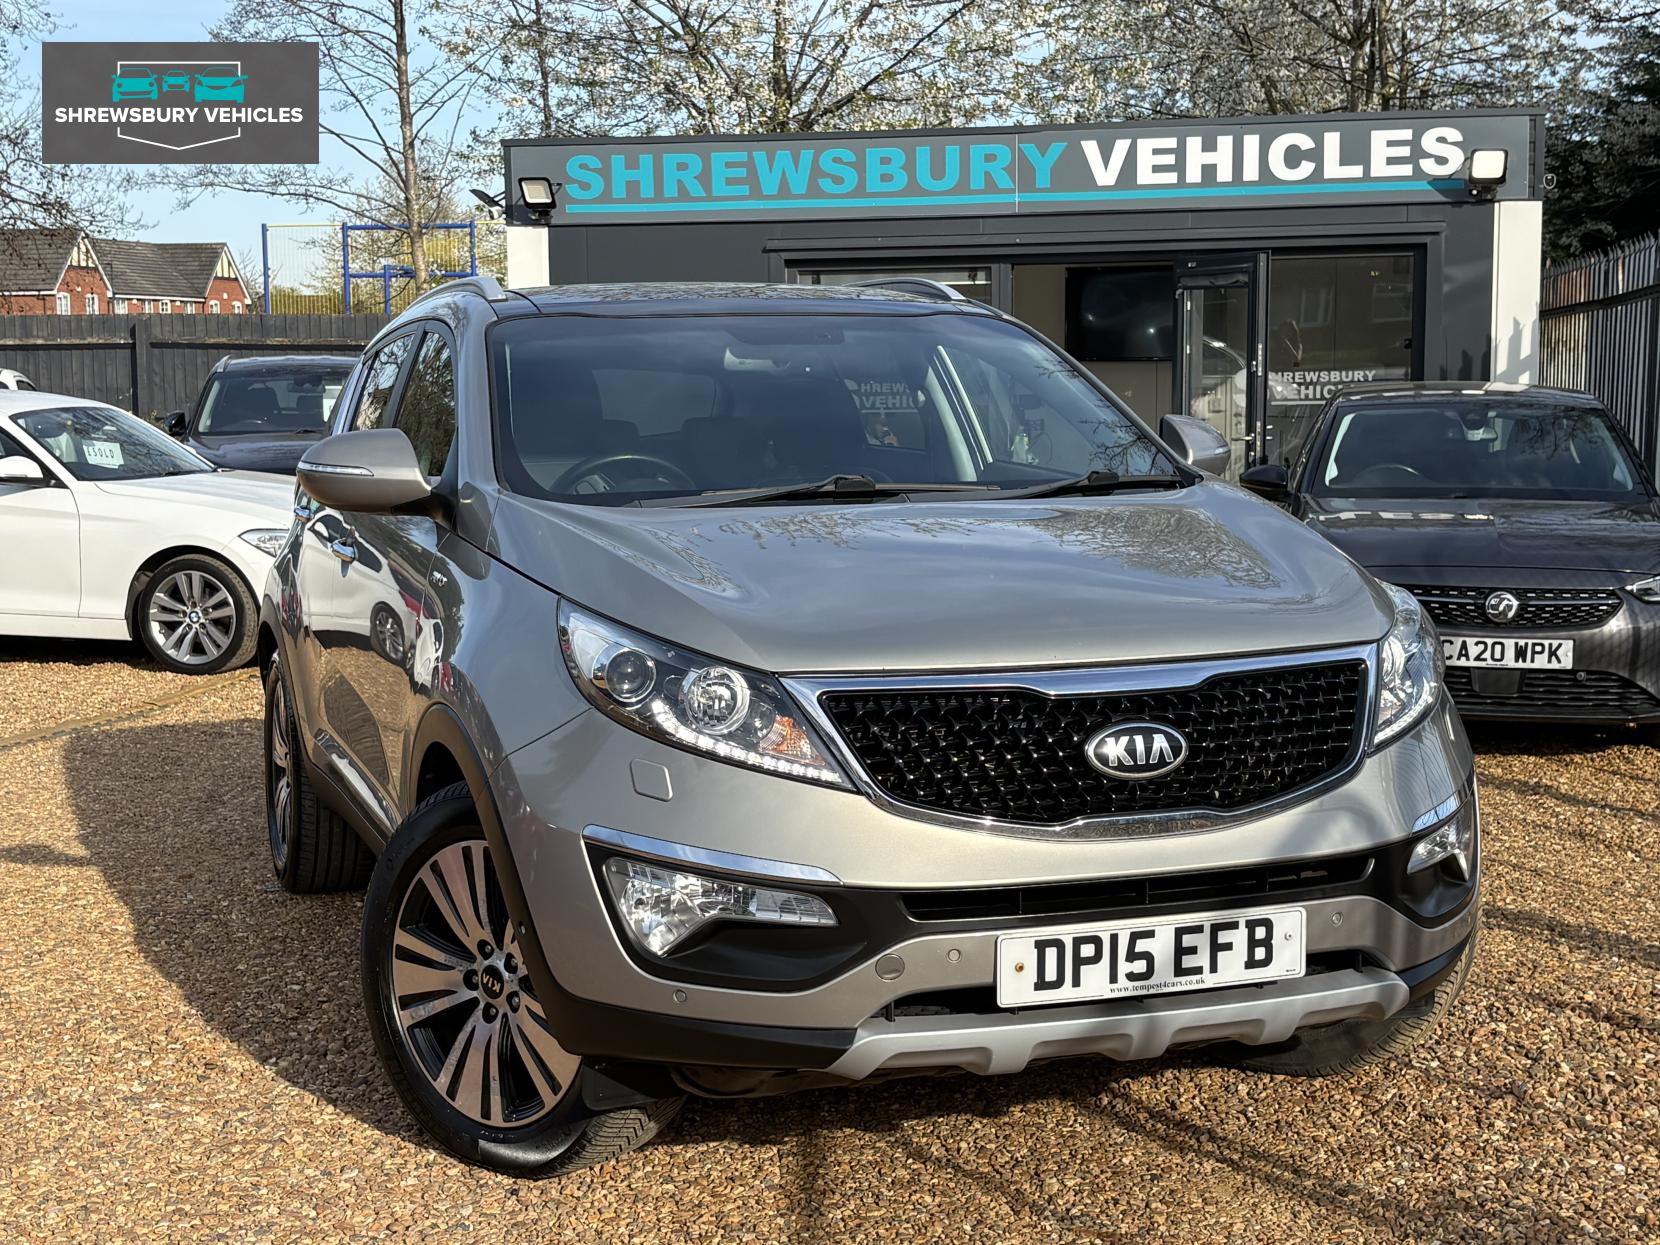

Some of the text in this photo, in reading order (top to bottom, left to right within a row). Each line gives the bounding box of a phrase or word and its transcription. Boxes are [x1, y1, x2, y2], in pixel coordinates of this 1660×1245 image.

[565, 126, 1466, 200] SHREWSBURY VEHICLES
[1441, 639, 1563, 664] CA20 WPK
[1104, 733, 1174, 767] KIA
[1034, 917, 1274, 991] DP15 EFB
